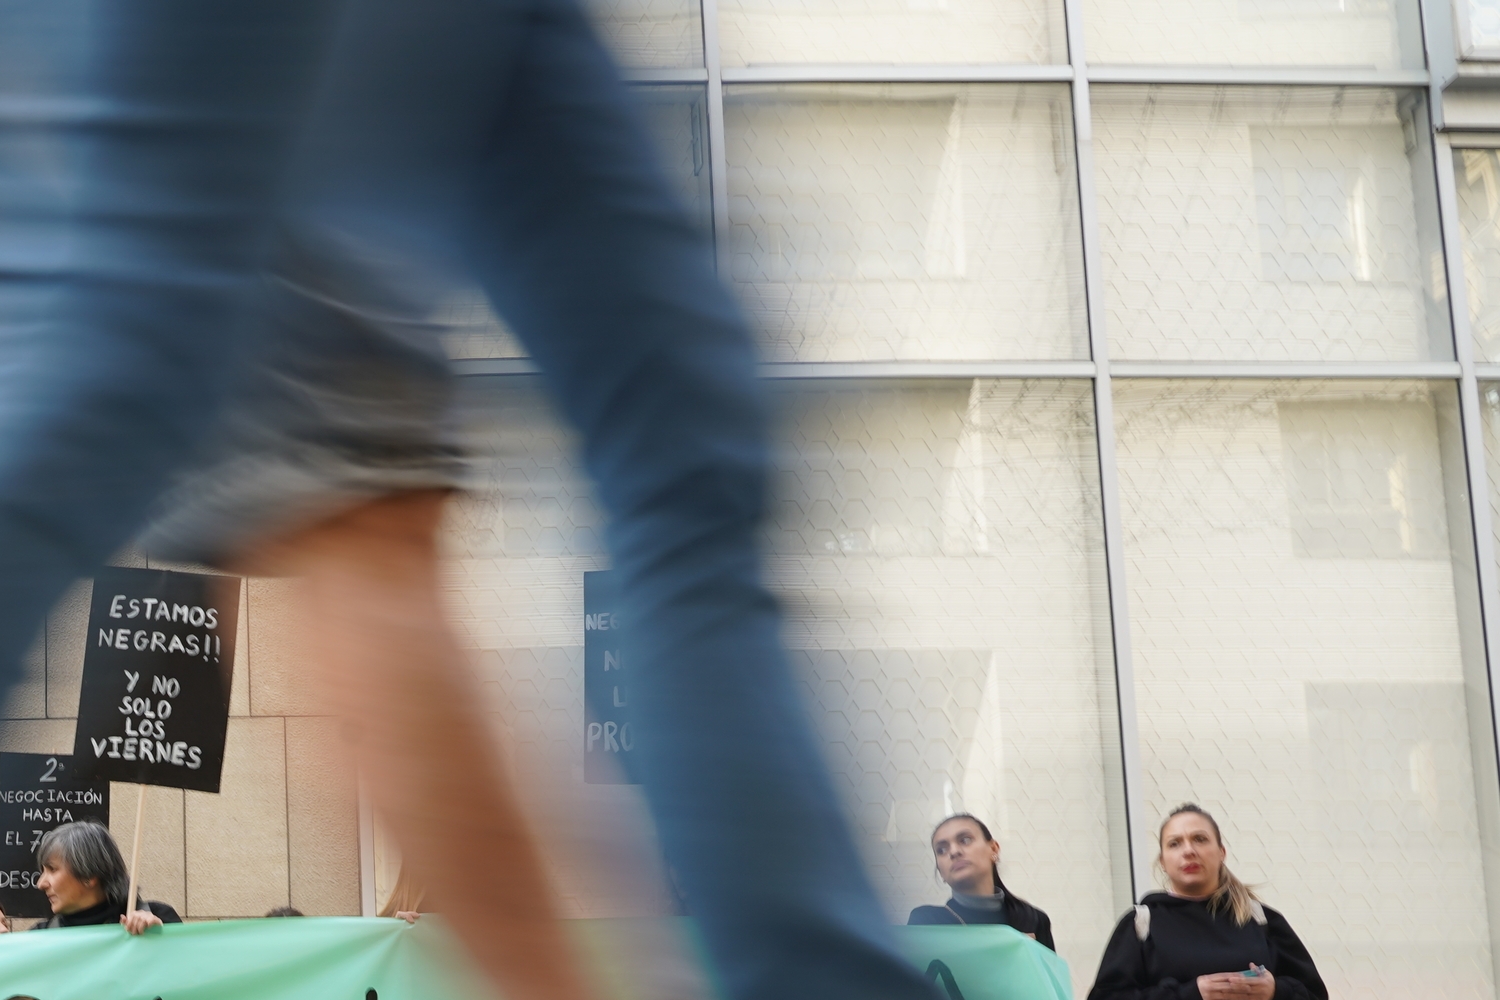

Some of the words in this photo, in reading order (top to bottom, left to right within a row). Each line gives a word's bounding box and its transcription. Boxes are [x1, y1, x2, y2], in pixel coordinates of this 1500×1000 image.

[109, 594, 219, 630] ESTAMOS
[98, 628, 221, 663] NEGRAS!!
[123, 669, 140, 693] Y
[151, 674, 181, 698] NO
[117, 695, 172, 720] SOLO
[124, 716, 166, 741] LOS
[90, 735, 202, 770] VIERNES
[23, 807, 74, 823] HASTA
[5, 830, 24, 846] EL
